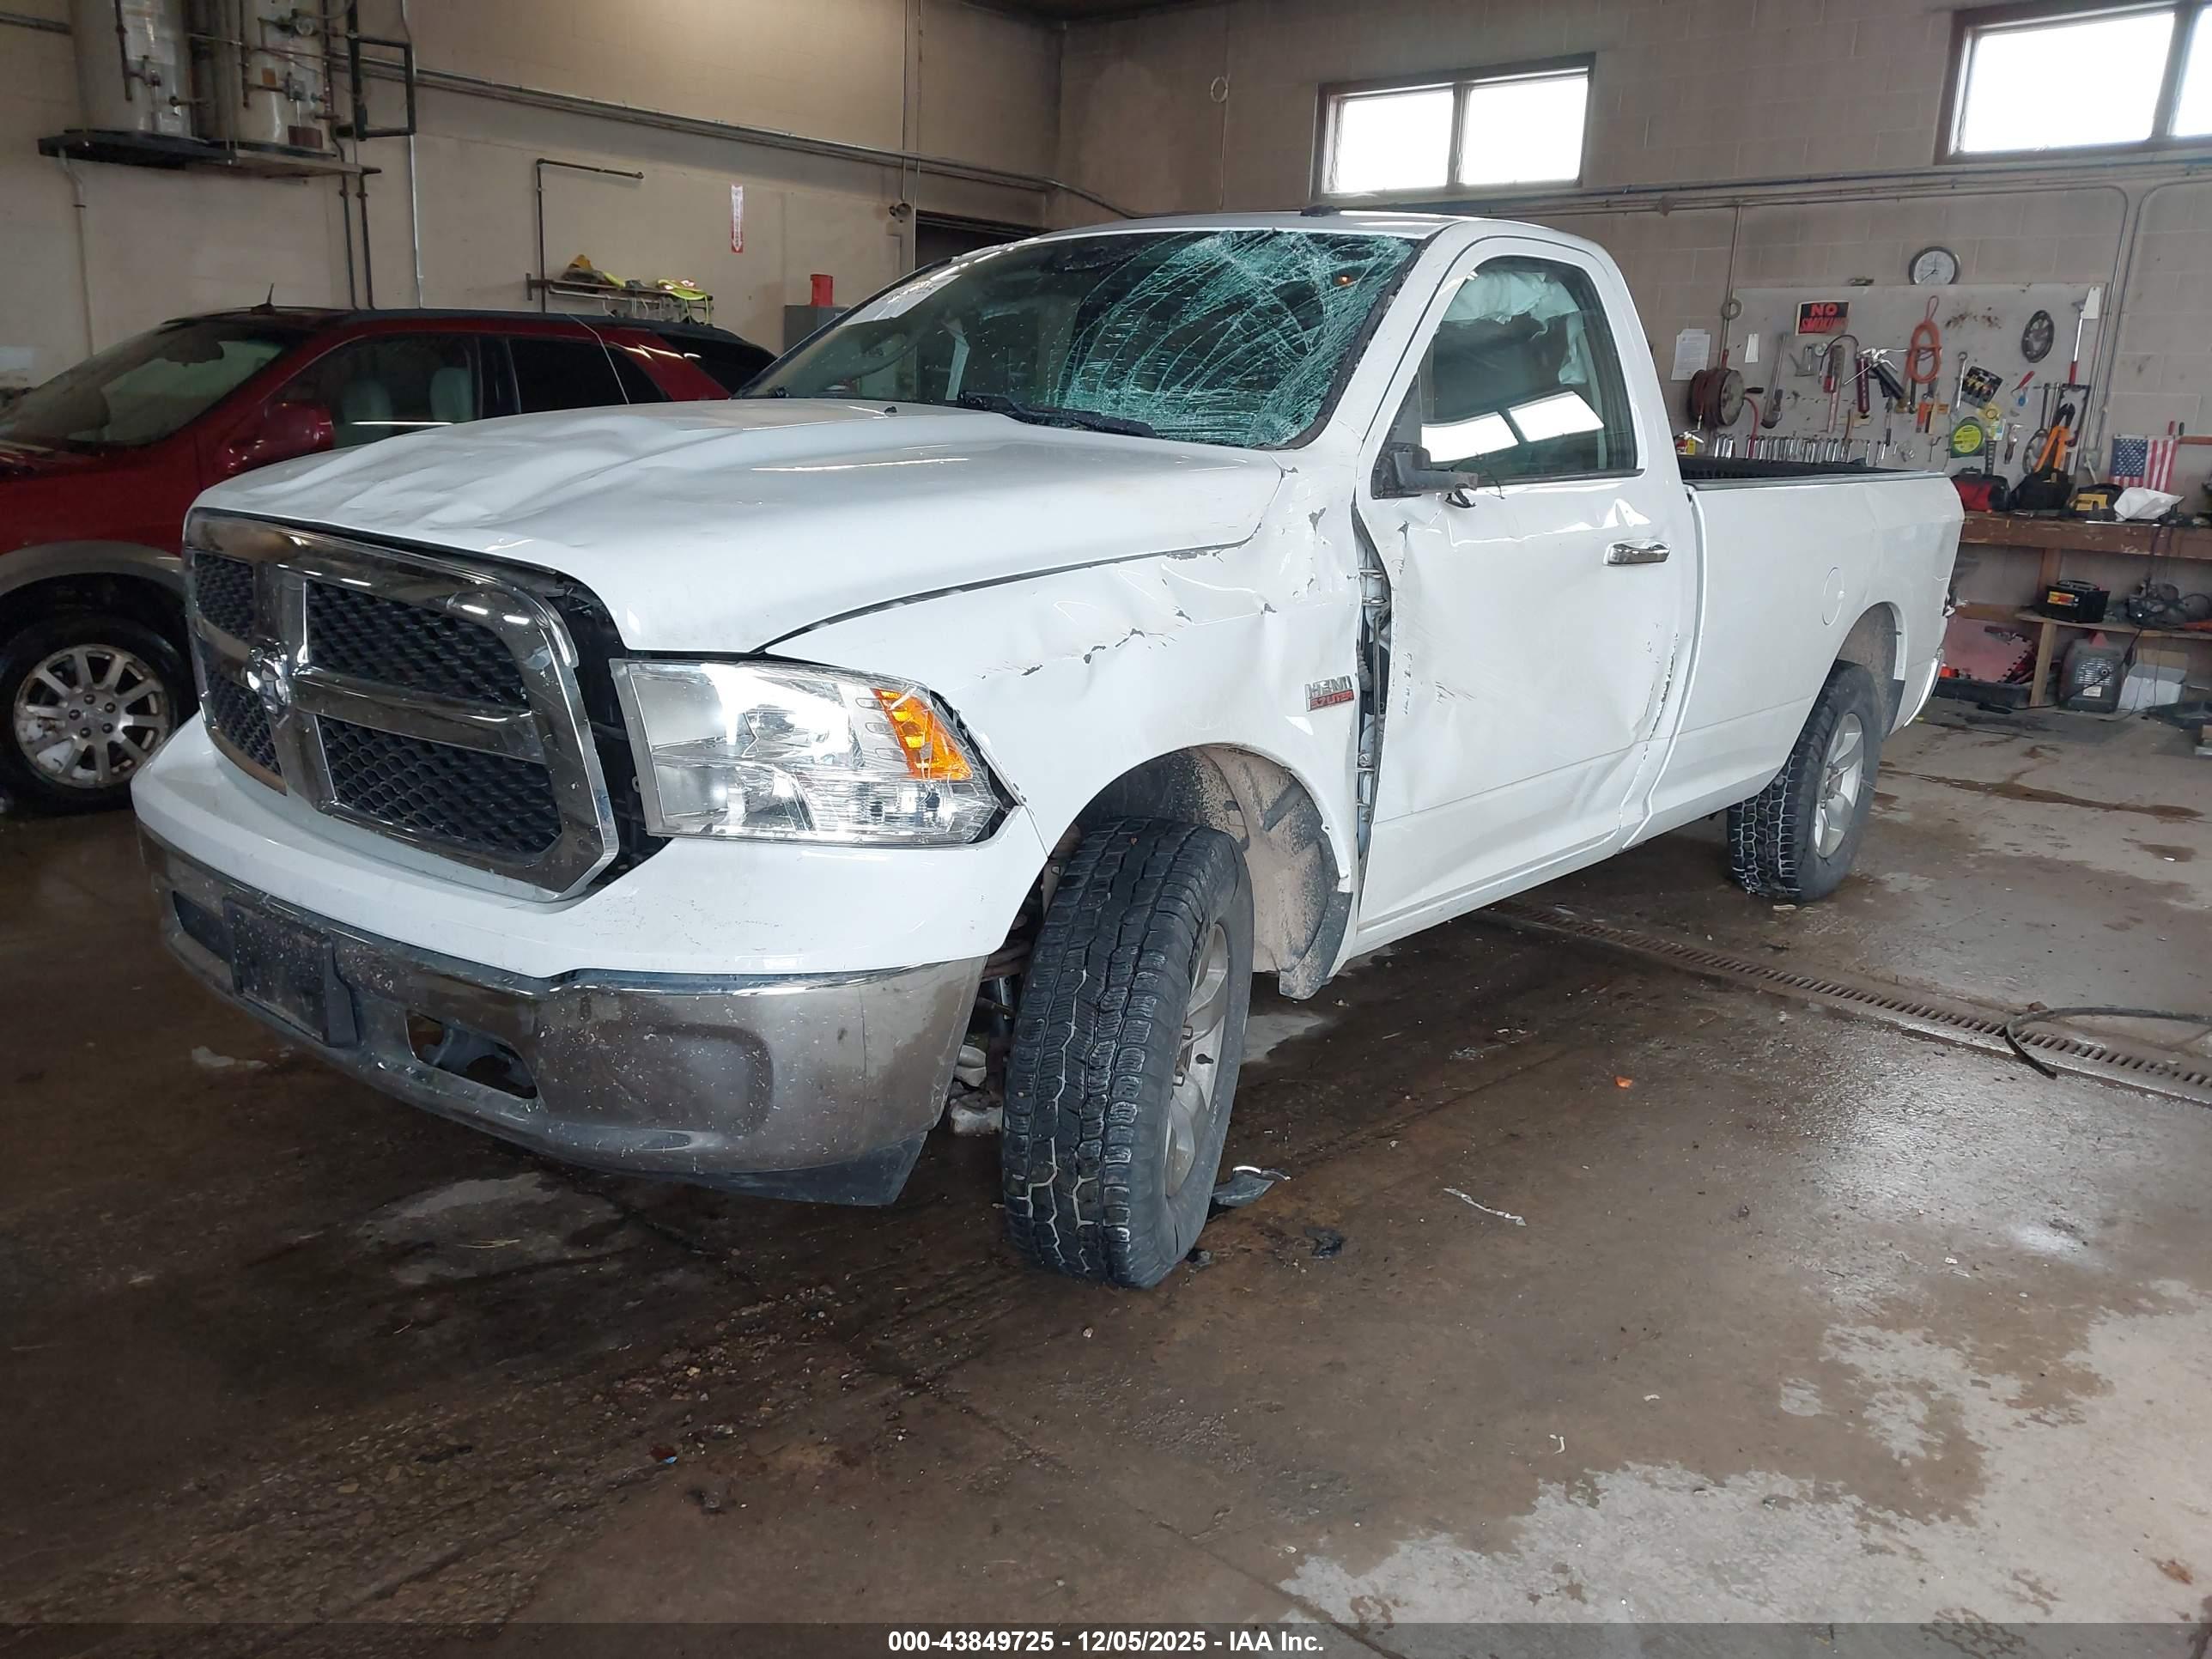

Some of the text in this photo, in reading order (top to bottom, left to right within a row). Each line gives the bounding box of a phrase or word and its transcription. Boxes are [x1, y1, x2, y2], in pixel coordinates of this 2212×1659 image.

[1810, 303, 1838, 317] NO
[1800, 317, 1847, 332] SMOKIN
[1305, 675, 1352, 700] HEMI
[1327, 690, 1353, 704] LITER
